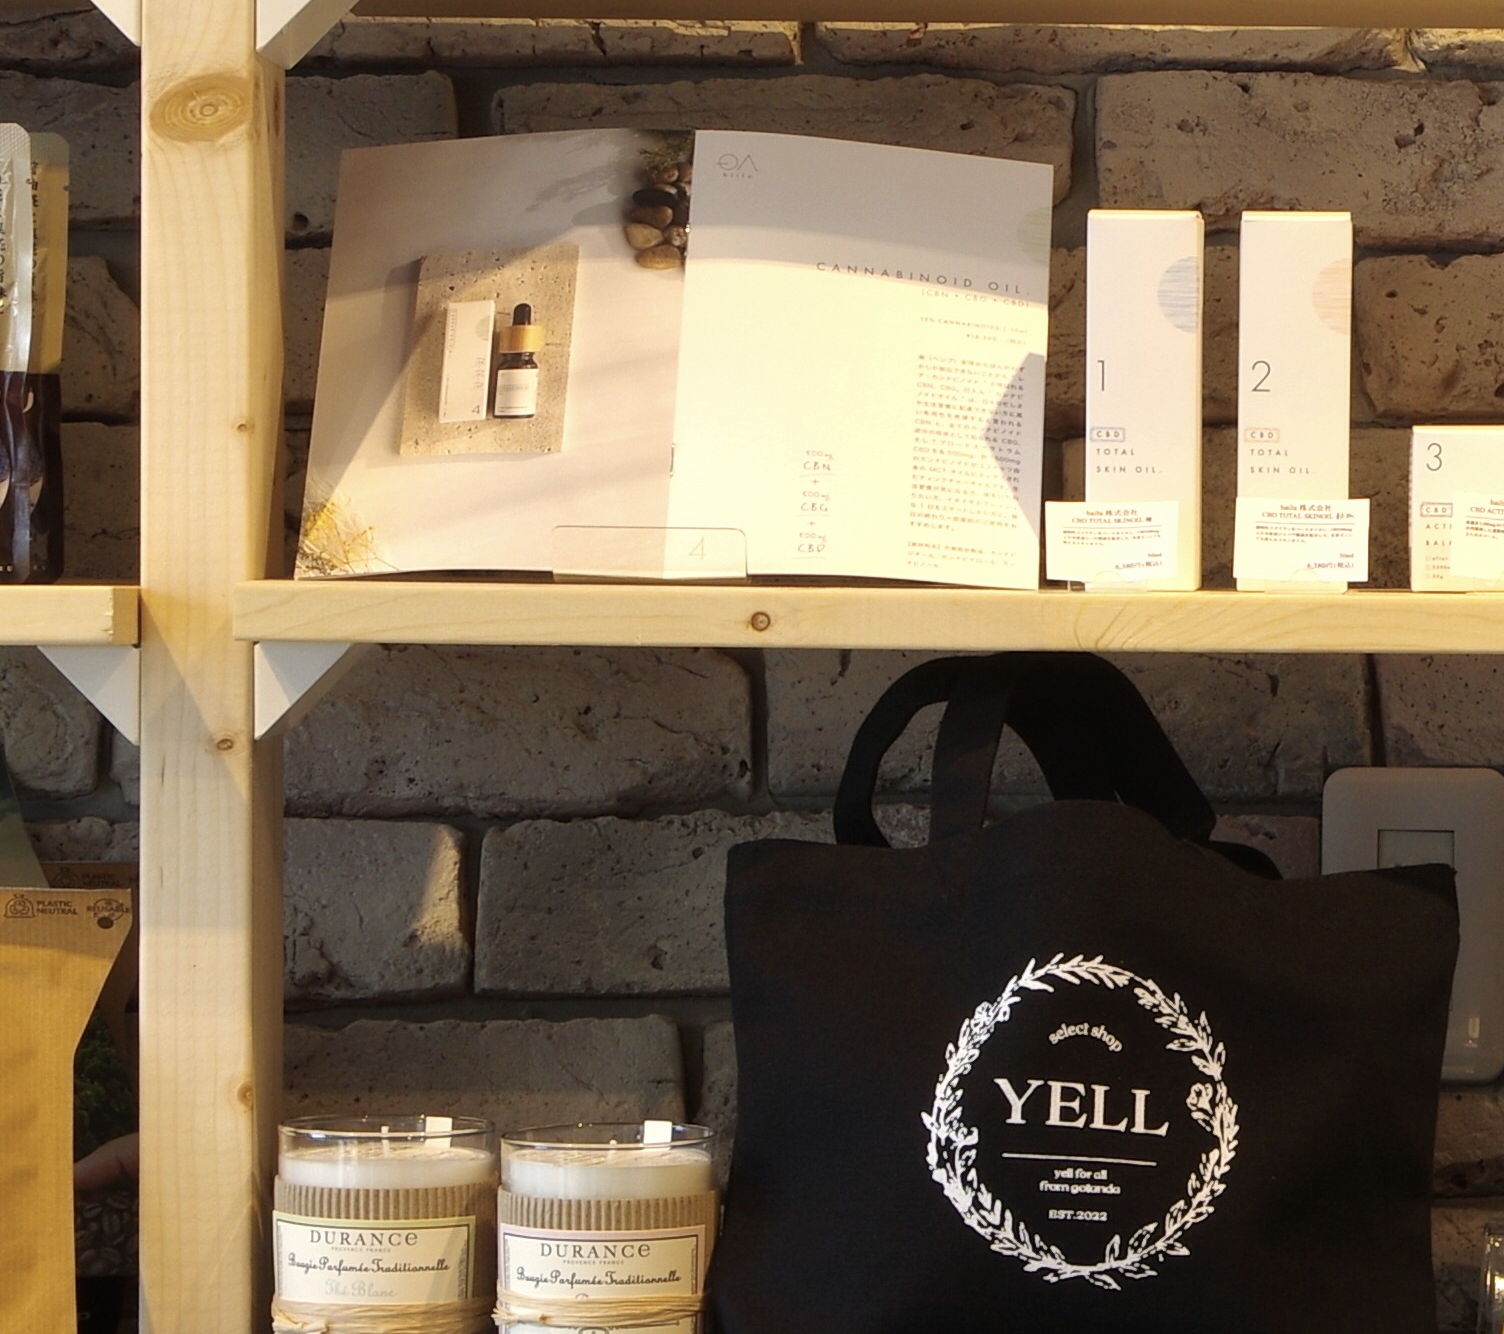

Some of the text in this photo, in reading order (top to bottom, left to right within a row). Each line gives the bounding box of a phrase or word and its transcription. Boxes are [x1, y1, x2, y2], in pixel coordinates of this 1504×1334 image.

[817, 262, 972, 288] CANNABINOID
[1096, 448, 1134, 456] TOTAL
[1427, 443, 1442, 471] 3
[1049, 1023, 1122, 1052] select shop
[994, 1078, 1169, 1137] YELL
[1054, 1168, 1107, 1179] yell for all
[1039, 1181, 1120, 1194] from gotanda
